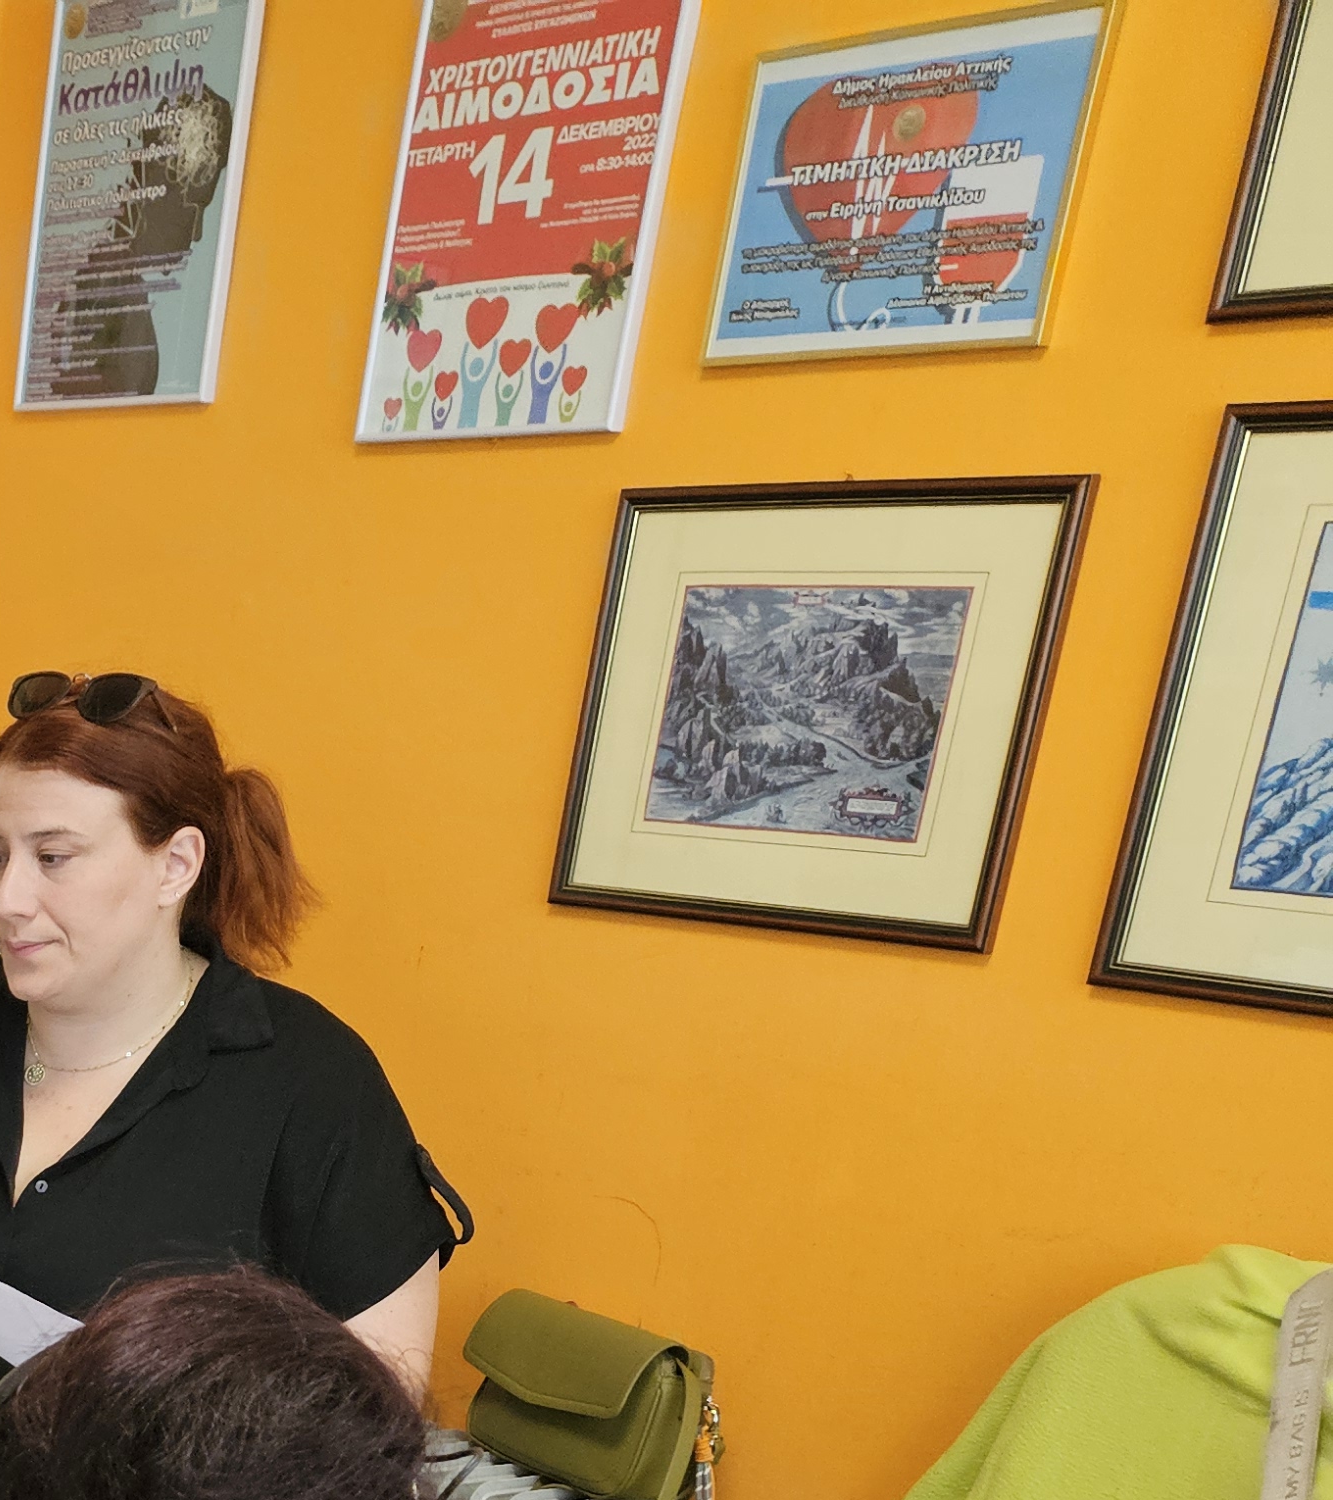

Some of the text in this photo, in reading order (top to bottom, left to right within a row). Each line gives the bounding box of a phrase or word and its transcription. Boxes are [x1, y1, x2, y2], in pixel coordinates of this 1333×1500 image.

[62, 26, 213, 75] Προσεγγίζοντας την
[425, 26, 662, 94] ΧΡΙΣΤΟΥΓΕΝΝΙΑΤΙΚΗ
[832, 54, 1013, 96] Δήμος Ηρακλείου Αττικής
[58, 58, 204, 116] Κατάθλιψη
[411, 57, 660, 134] ΑΙΜΟΔΟΣΙΑ
[53, 104, 183, 146] σε όλες τις ηλικίες
[556, 113, 661, 144] ΔΕΚΕΜΒΡΙΟΥ
[622, 133, 657, 151] 2022
[408, 141, 476, 168] ΤΕΤΑΡΤΗ
[468, 126, 555, 226] 14
[791, 140, 1023, 187] ΤΙΜΗΤΙΚΗ ΔΙΑΚΡΙΣΗ
[830, 198, 882, 220] Ειρήνη
[888, 187, 986, 213] Τσανικλίδου
[1288, 1299, 1324, 1368] FRNC
[1285, 1389, 1309, 1499] MY BAG IS
